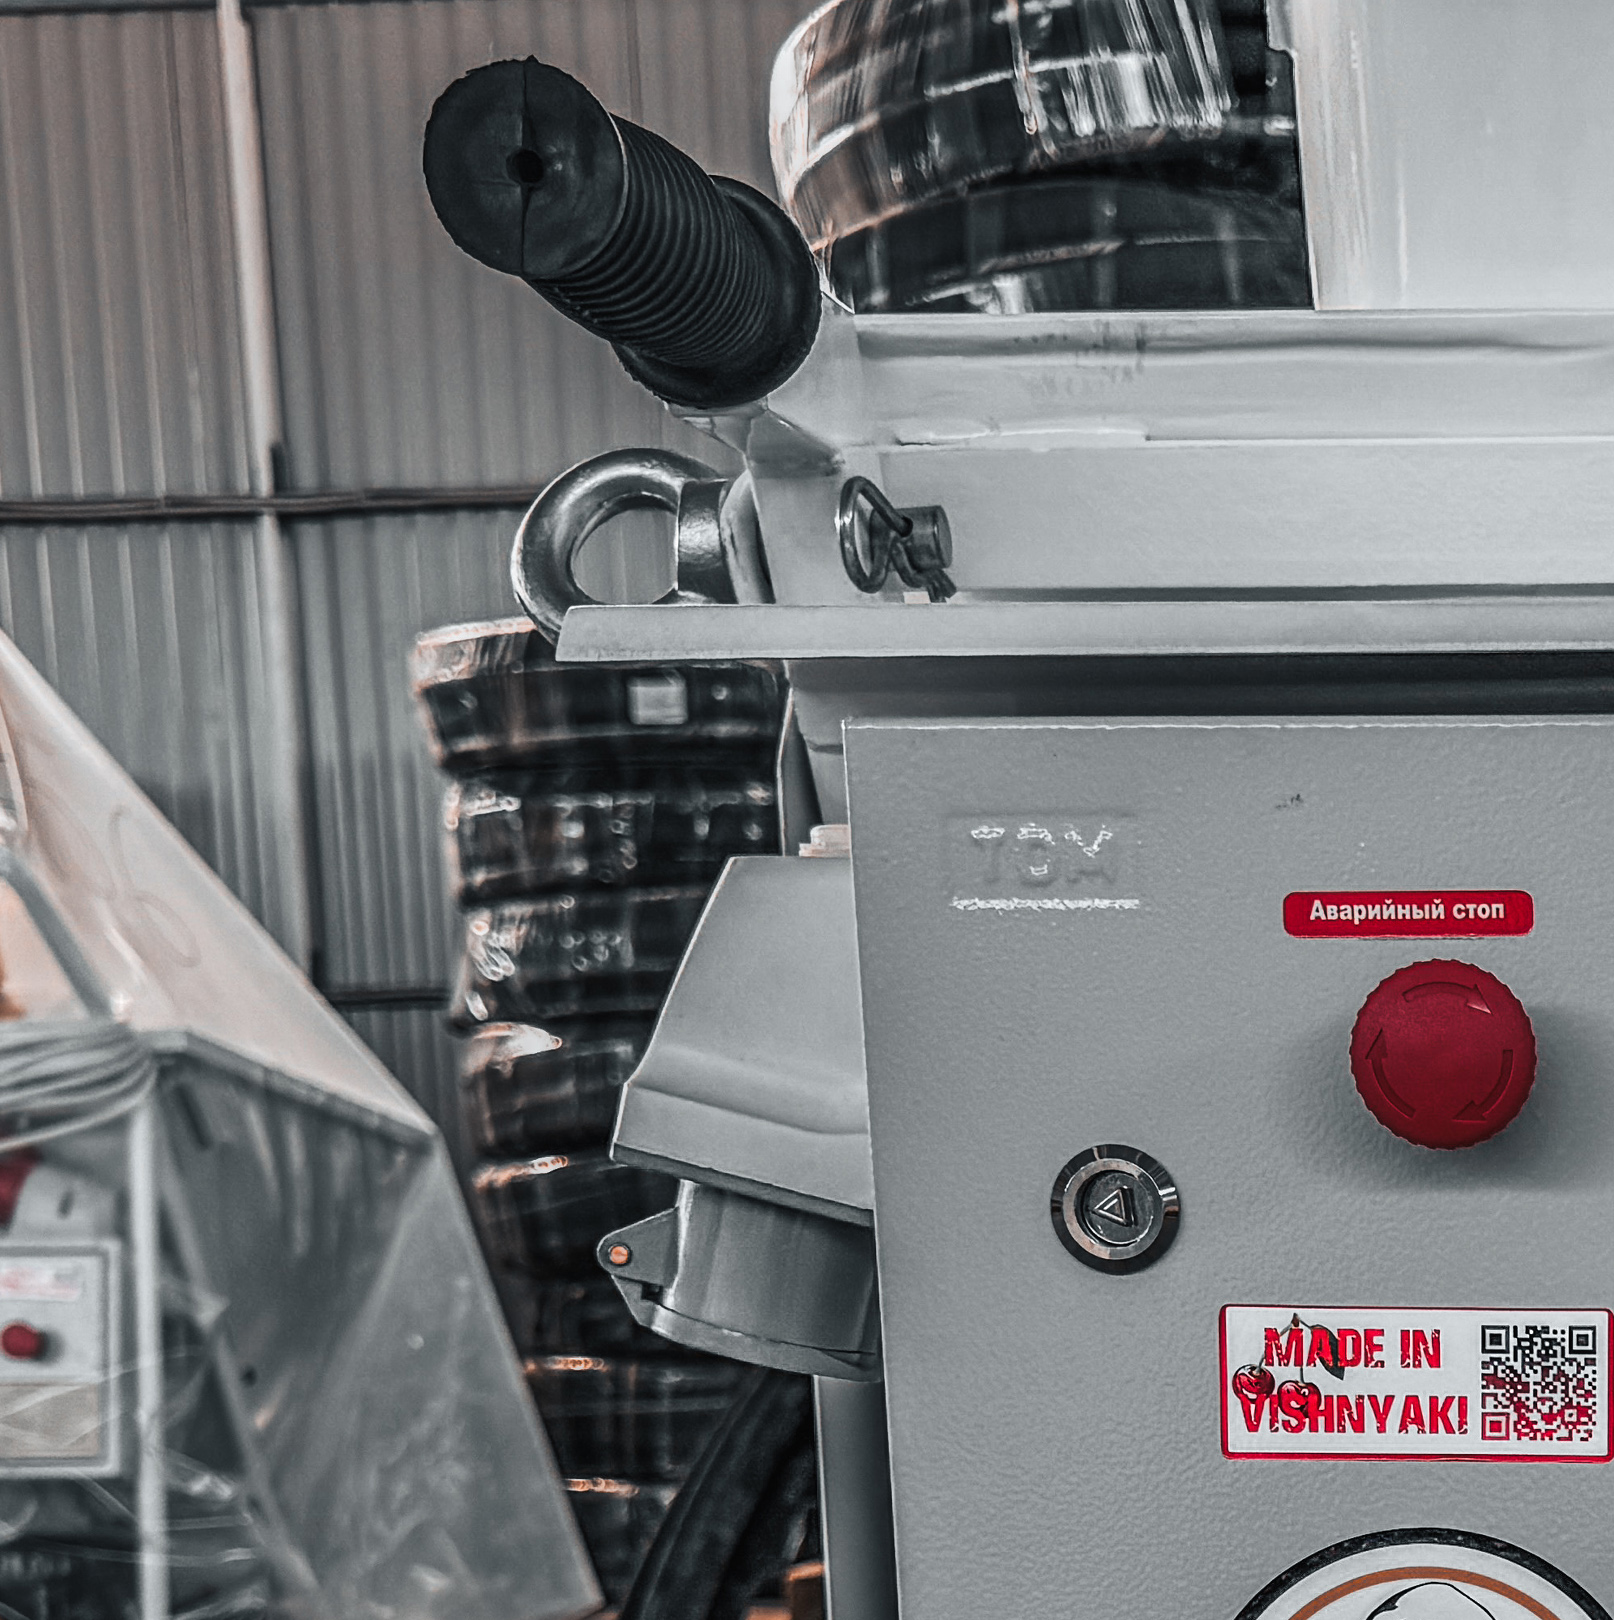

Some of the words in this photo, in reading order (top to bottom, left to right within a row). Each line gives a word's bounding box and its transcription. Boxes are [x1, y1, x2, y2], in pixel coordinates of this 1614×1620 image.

[1310, 897, 1446, 922] Аварийный
[1452, 900, 1505, 922] стоп
[1263, 1327, 1385, 1369] MADE
[1400, 1328, 1442, 1369] IN
[1239, 1393, 1468, 1435] VISHNYAKI
